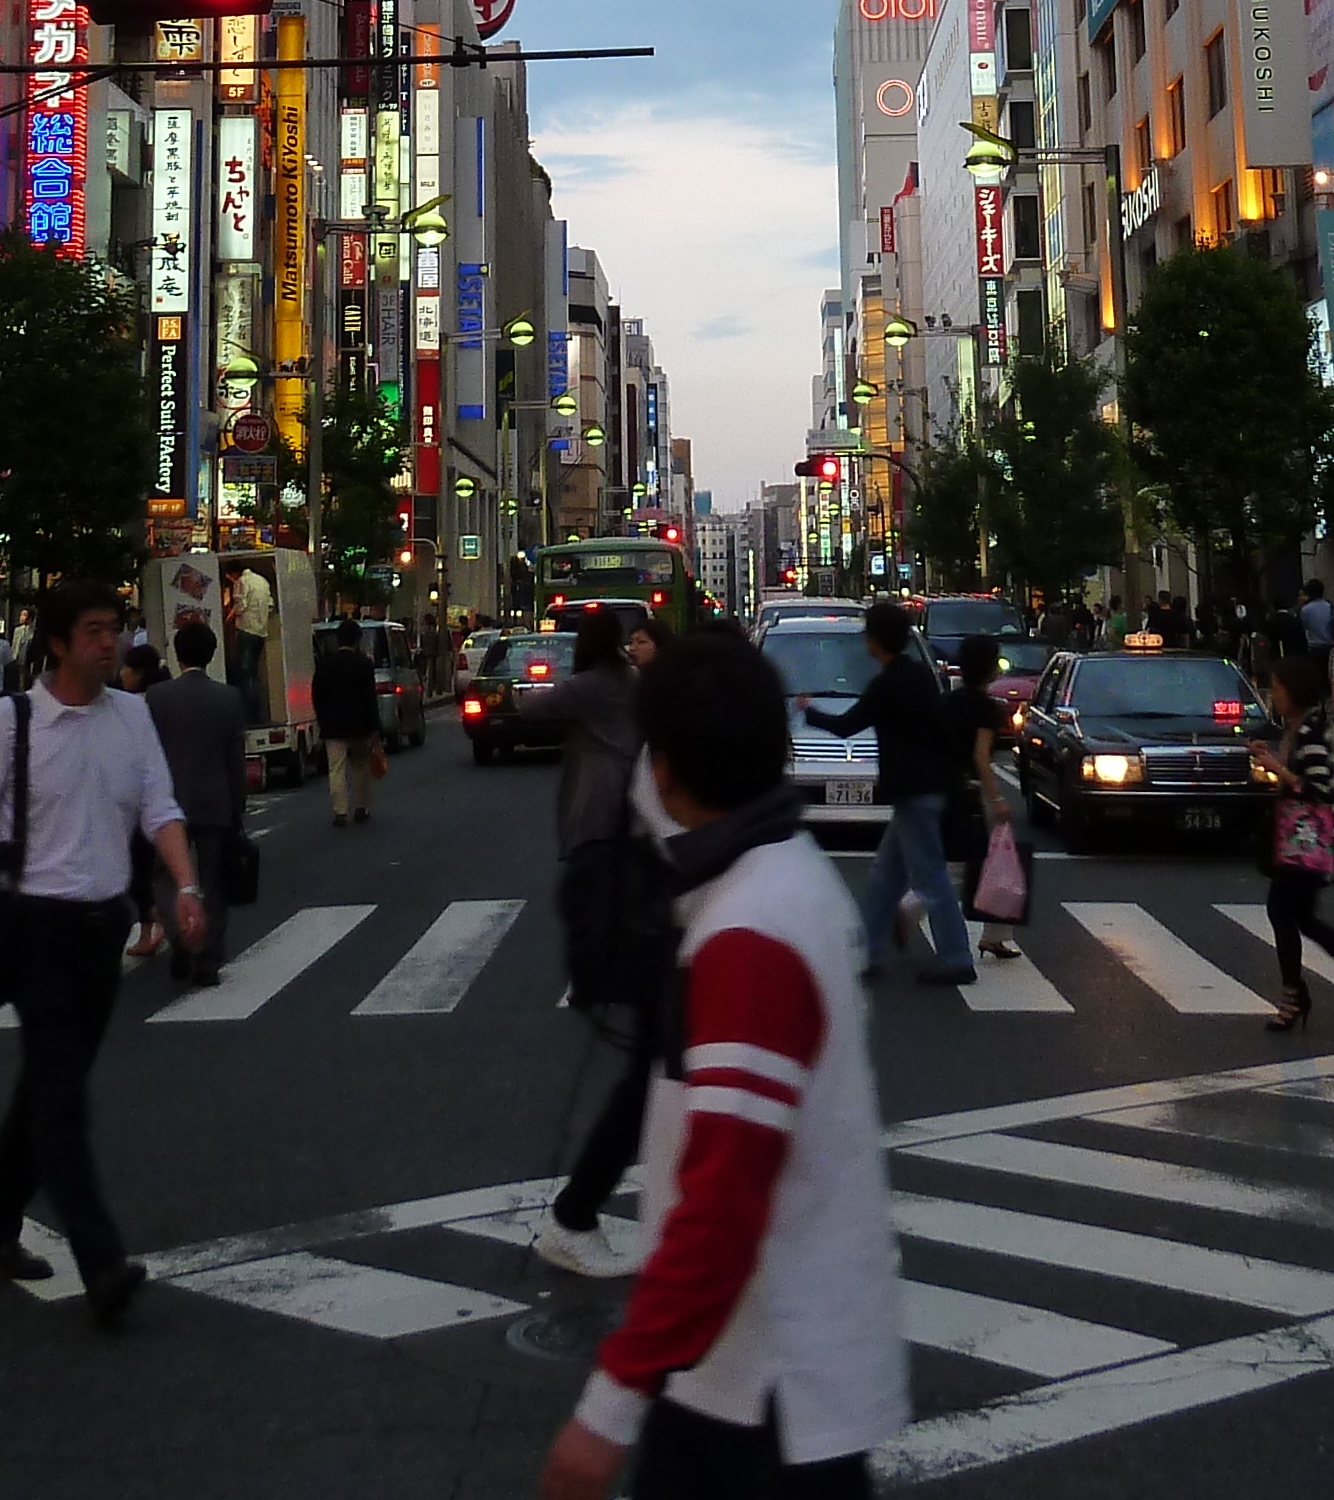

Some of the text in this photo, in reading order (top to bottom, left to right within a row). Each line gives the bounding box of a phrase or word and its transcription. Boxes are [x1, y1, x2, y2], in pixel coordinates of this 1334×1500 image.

[228, 87, 247, 98] 5F
[221, 155, 252, 233] ちゃんと
[280, 105, 299, 302] KiYoshi Matsumoto
[160, 344, 177, 397] Perfect
[160, 400, 177, 435] Suit
[236, 423, 267, 441] 消火栓
